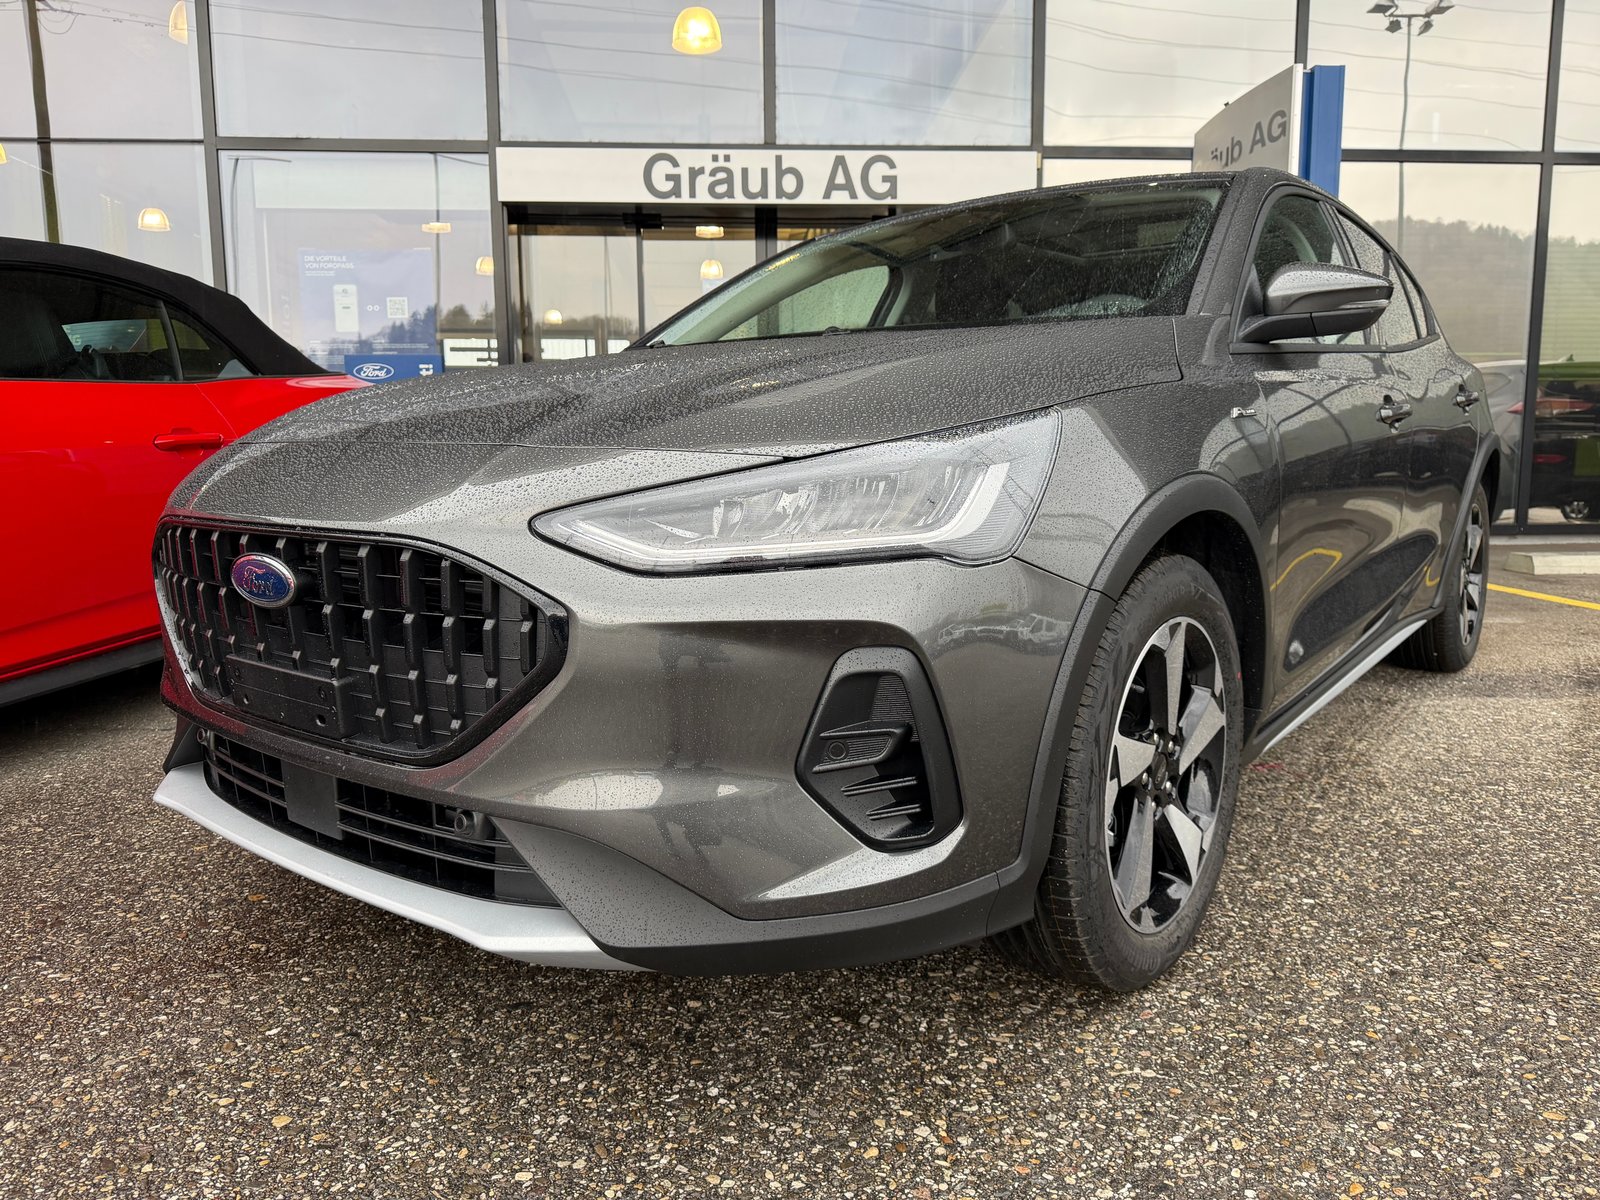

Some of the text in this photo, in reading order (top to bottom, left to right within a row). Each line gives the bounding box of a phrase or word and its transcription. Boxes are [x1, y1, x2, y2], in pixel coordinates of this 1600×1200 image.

[1249, 110, 1287, 154] AG
[643, 152, 898, 200] Gräub AG
[359, 364, 388, 378] Ford
[242, 564, 276, 597] Ford
